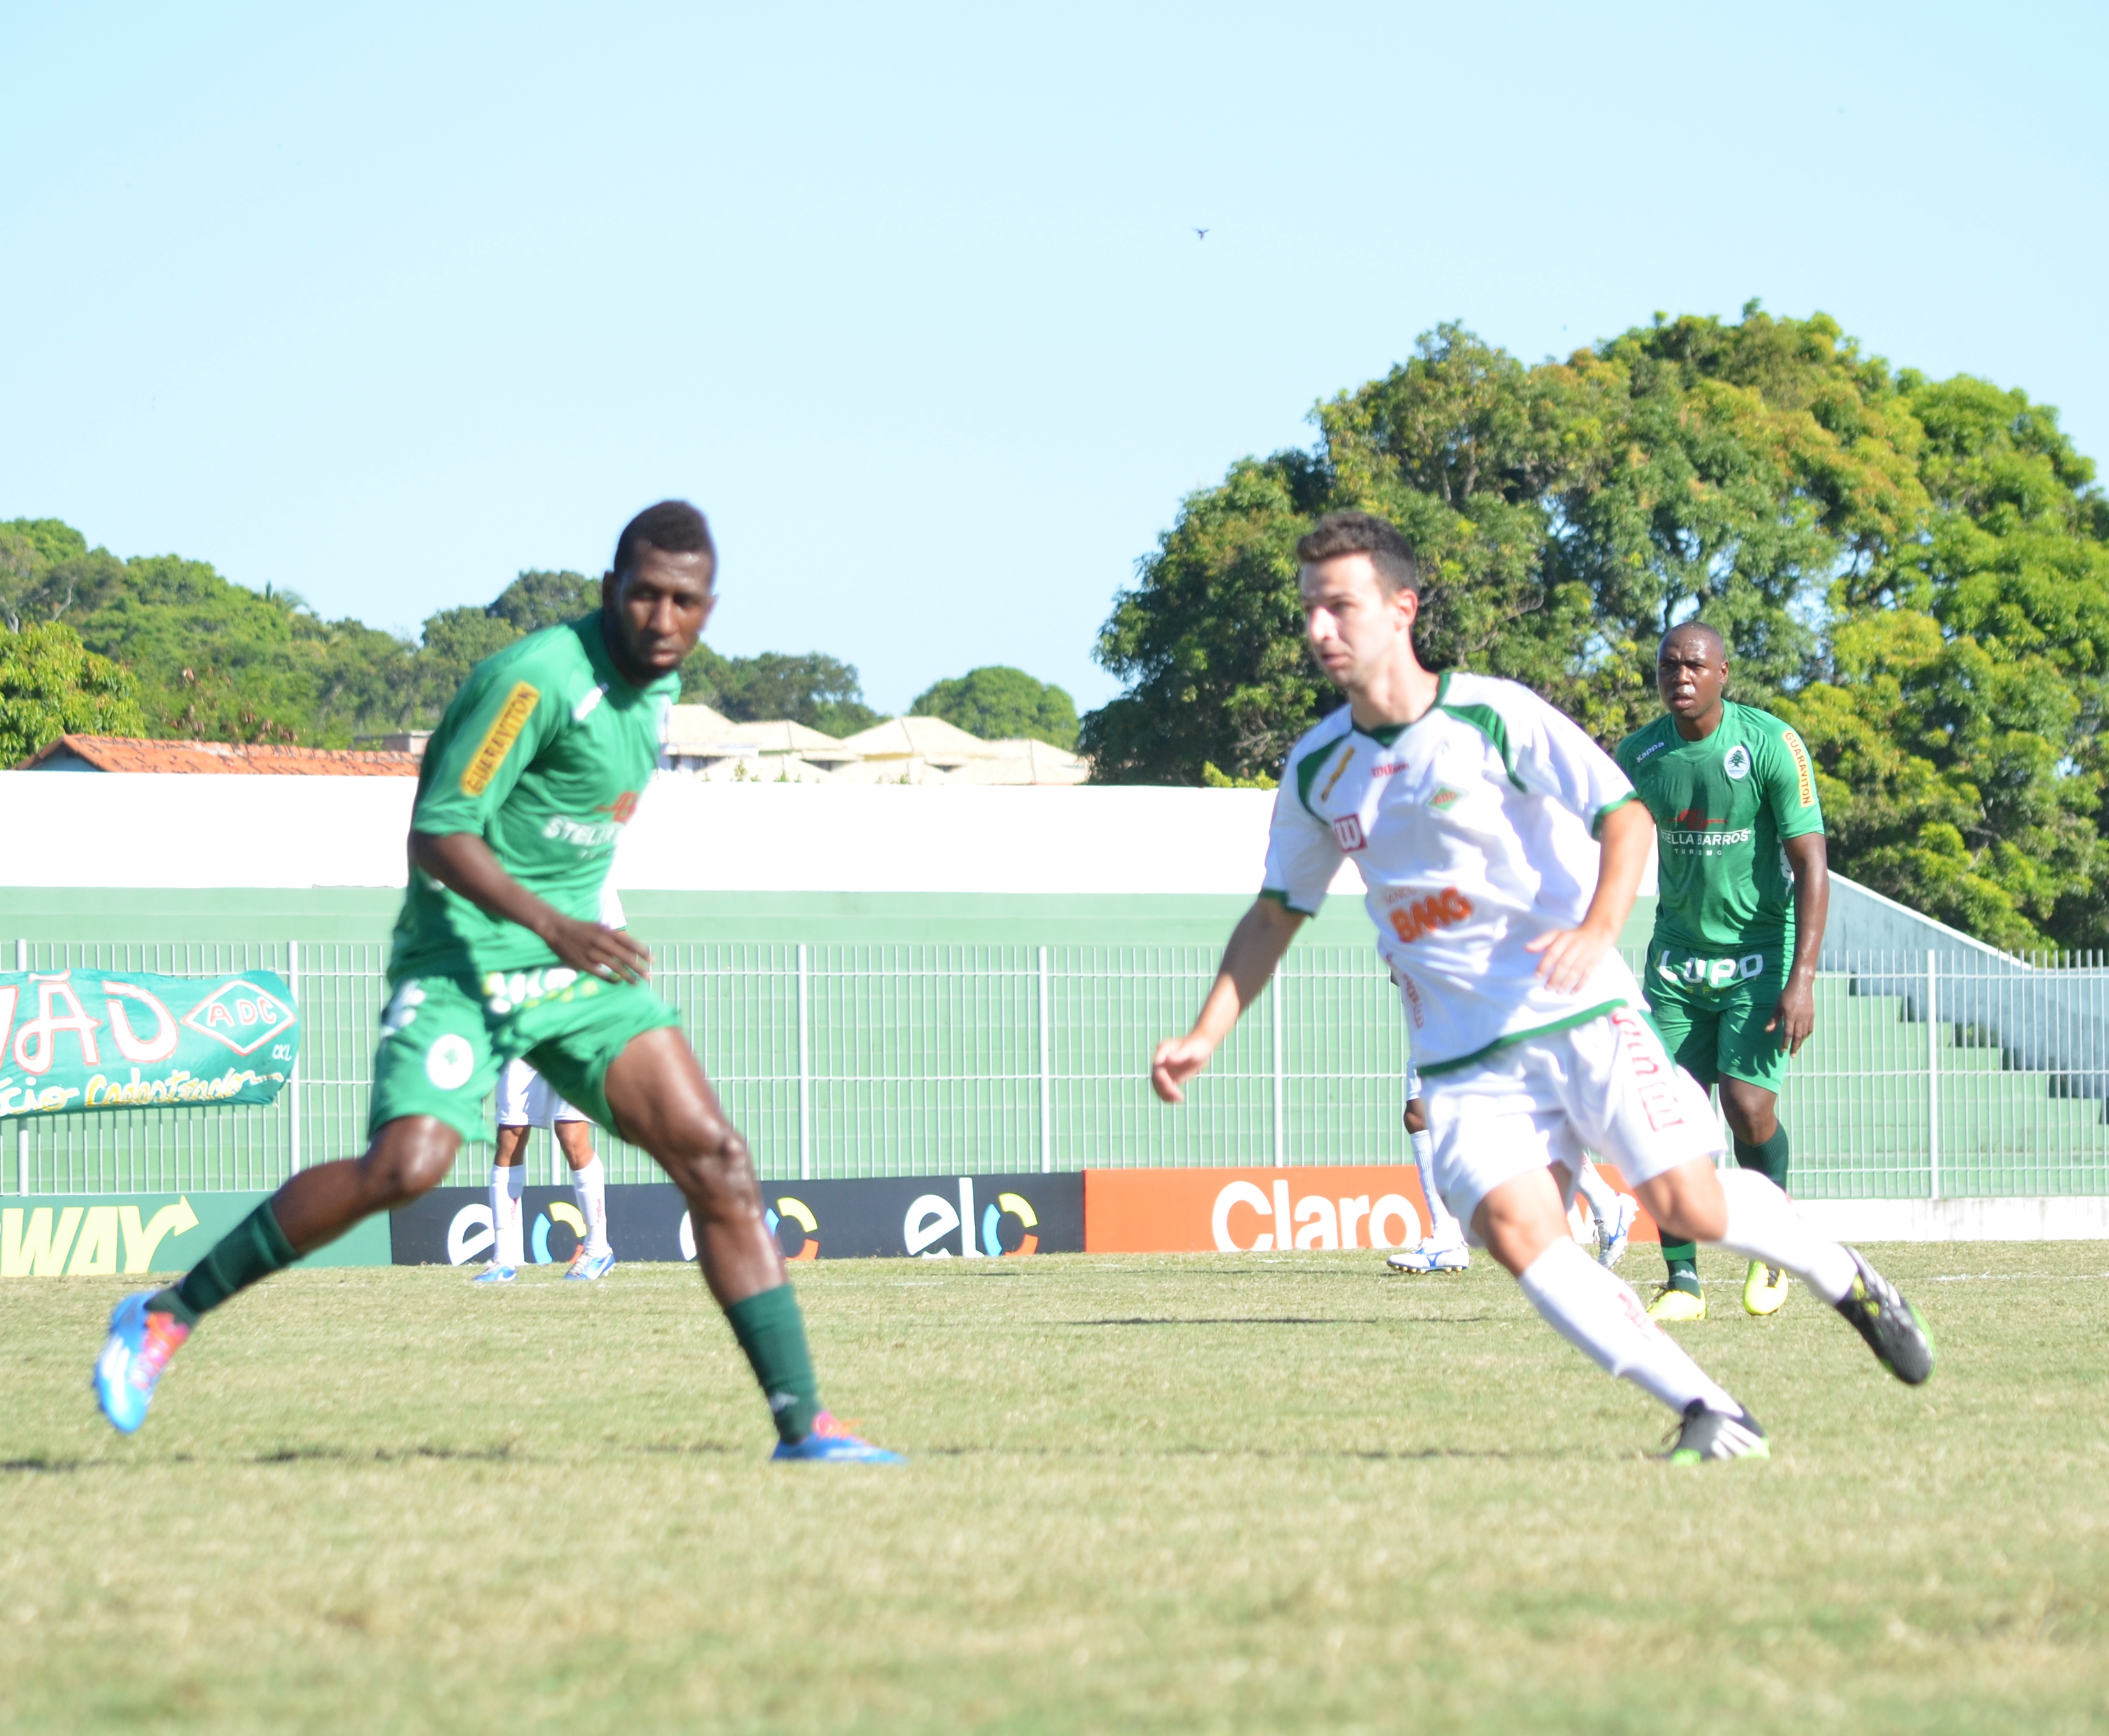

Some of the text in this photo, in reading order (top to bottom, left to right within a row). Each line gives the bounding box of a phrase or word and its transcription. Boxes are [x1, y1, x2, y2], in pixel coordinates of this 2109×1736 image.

[1636, 741, 1664, 763] Kappa
[1785, 732, 1812, 805] GUARAVITON
[1697, 832, 1750, 846] BARROS
[1390, 885, 1474, 944] BMG
[207, 996, 278, 1027] ADC
[903, 1177, 1038, 1259] elo
[1212, 1179, 1421, 1252] Claro
